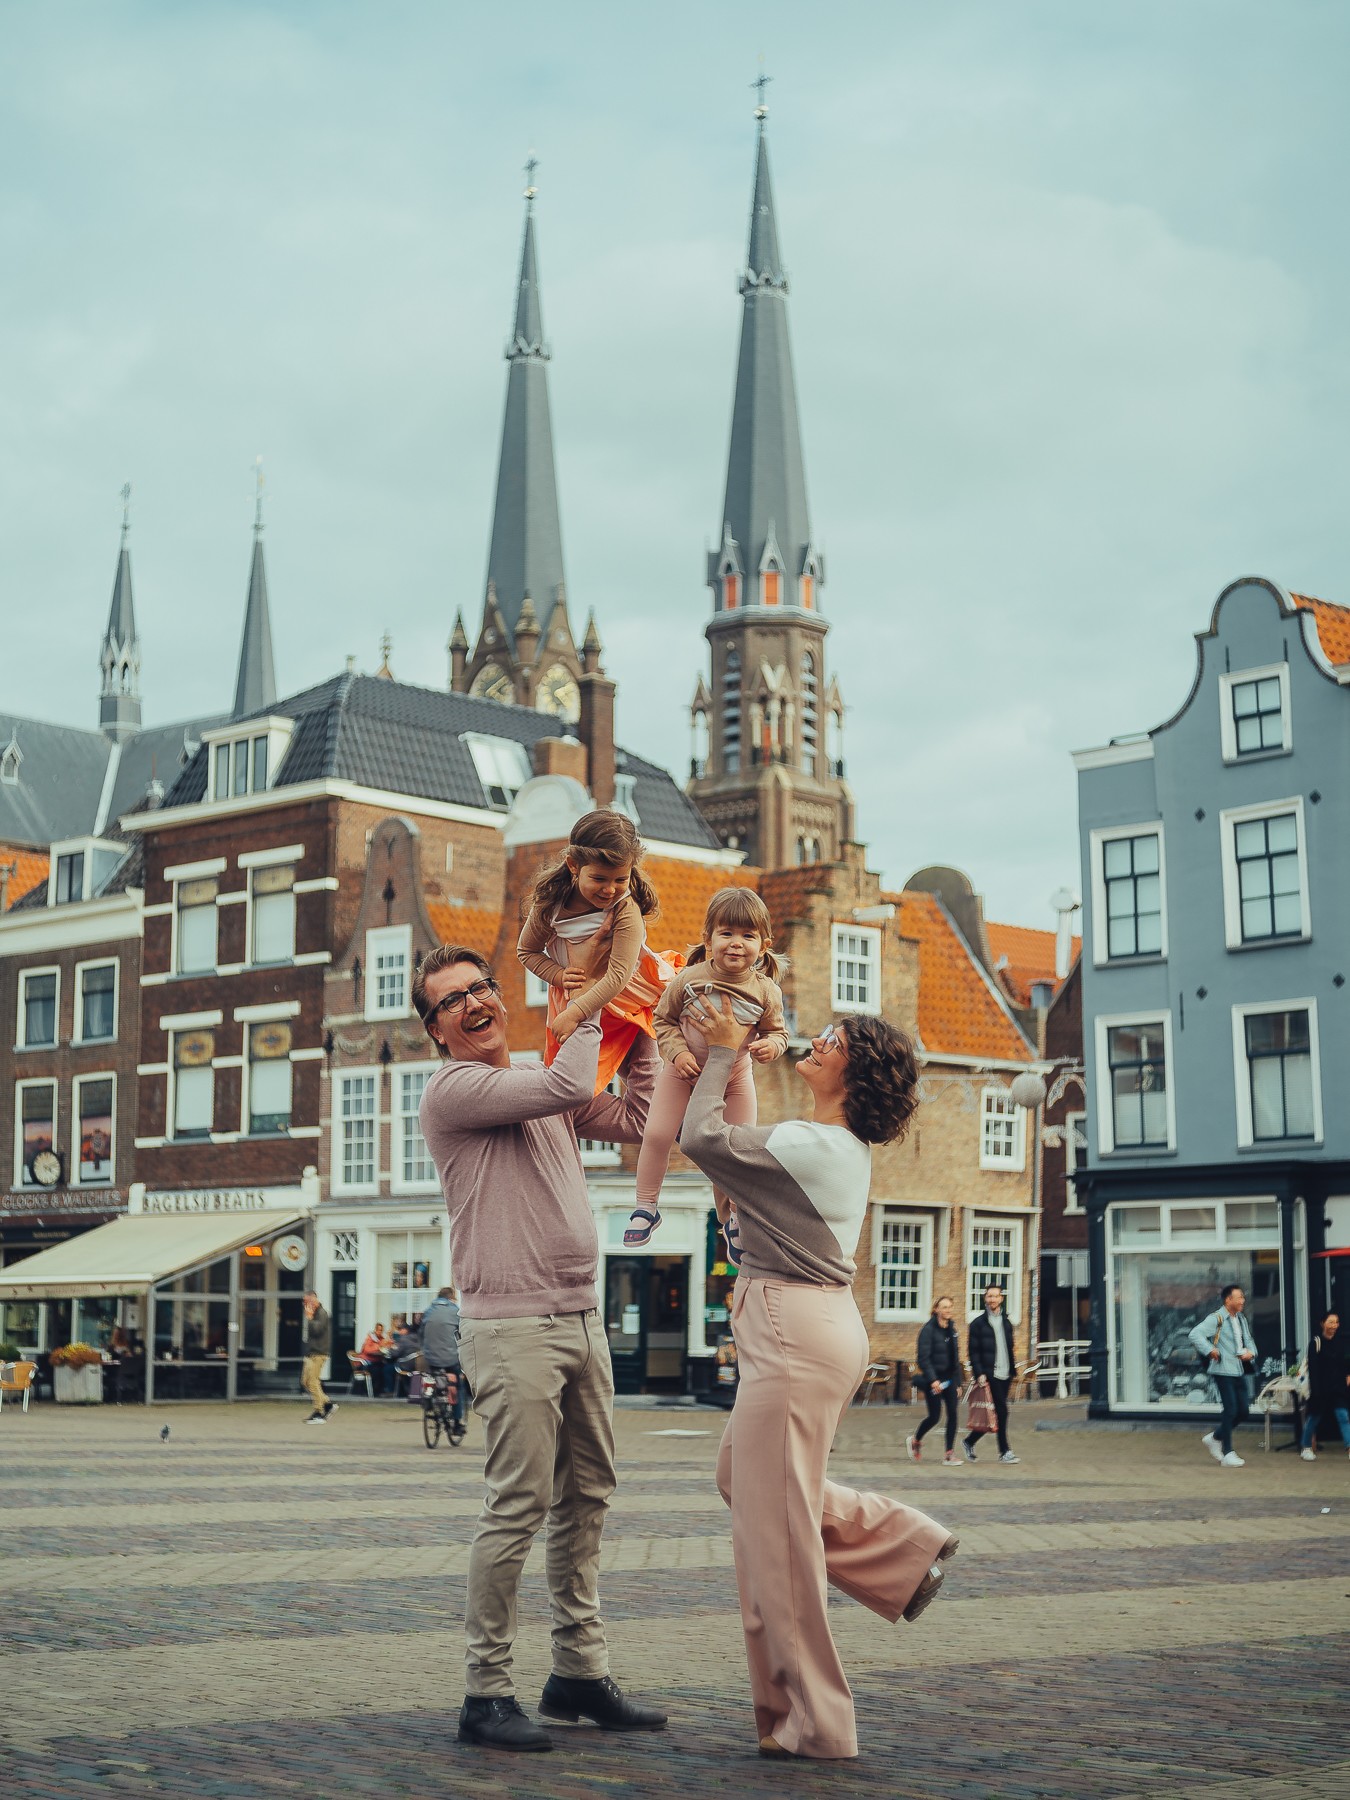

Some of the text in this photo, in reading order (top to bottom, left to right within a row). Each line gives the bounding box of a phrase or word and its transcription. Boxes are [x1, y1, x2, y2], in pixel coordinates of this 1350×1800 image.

[2, 1190, 121, 1210] CLOCKS & WATCHES
[143, 1193, 200, 1212] BAGELS
